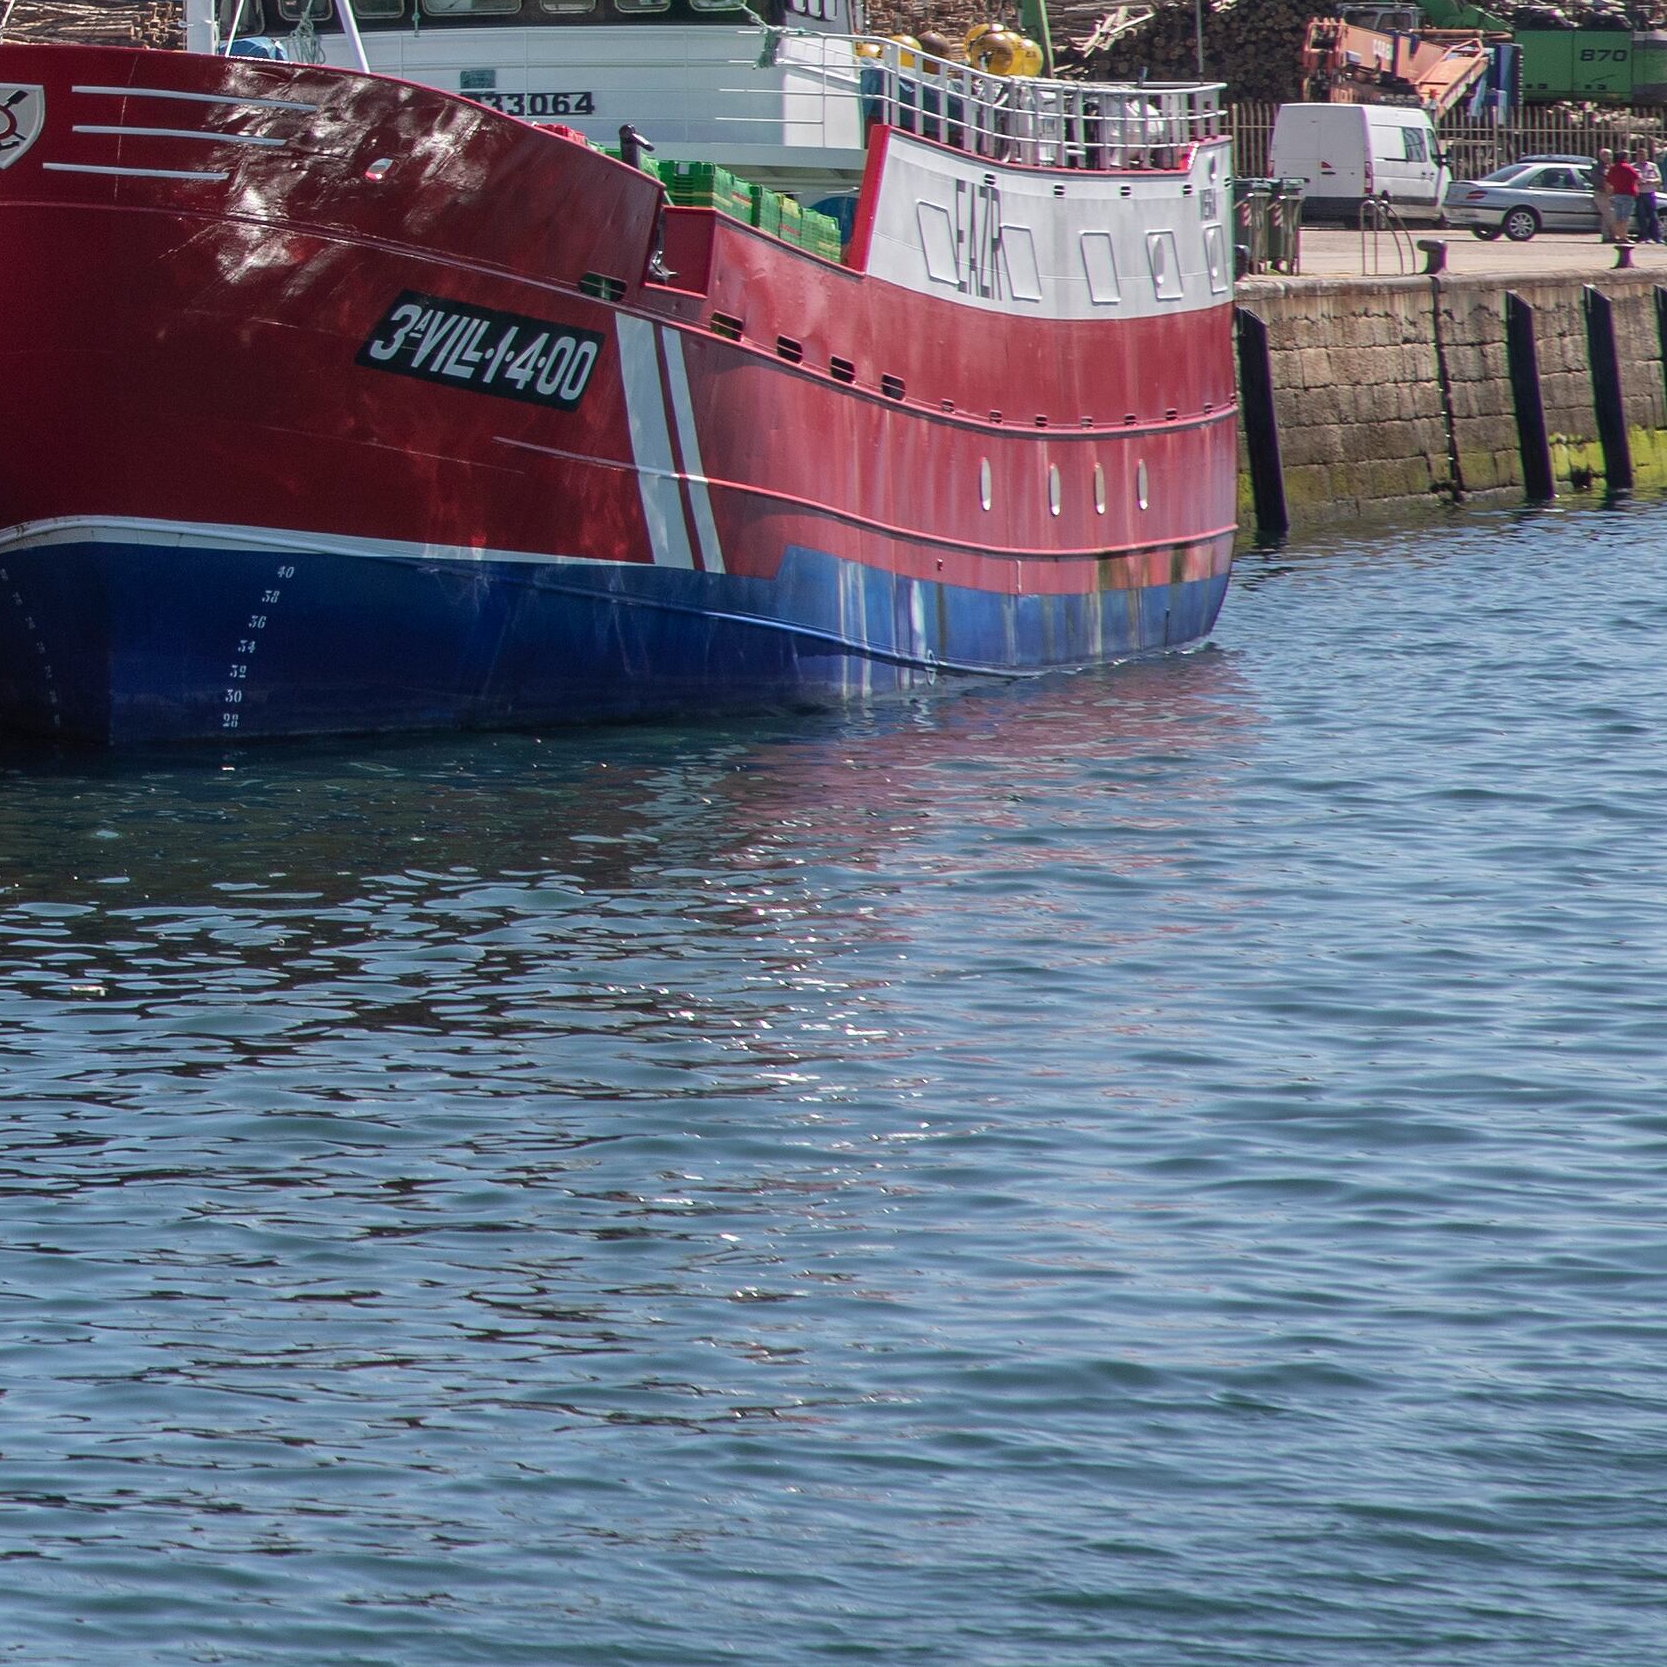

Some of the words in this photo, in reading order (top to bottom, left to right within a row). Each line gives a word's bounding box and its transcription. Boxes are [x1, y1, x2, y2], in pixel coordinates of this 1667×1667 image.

[1579, 49, 1628, 62] 870
[277, 566, 295, 578] 40
[262, 590, 280, 603] 38
[248, 615, 267, 629] 36
[225, 689, 242, 703] 30
[222, 713, 239, 728] 28
